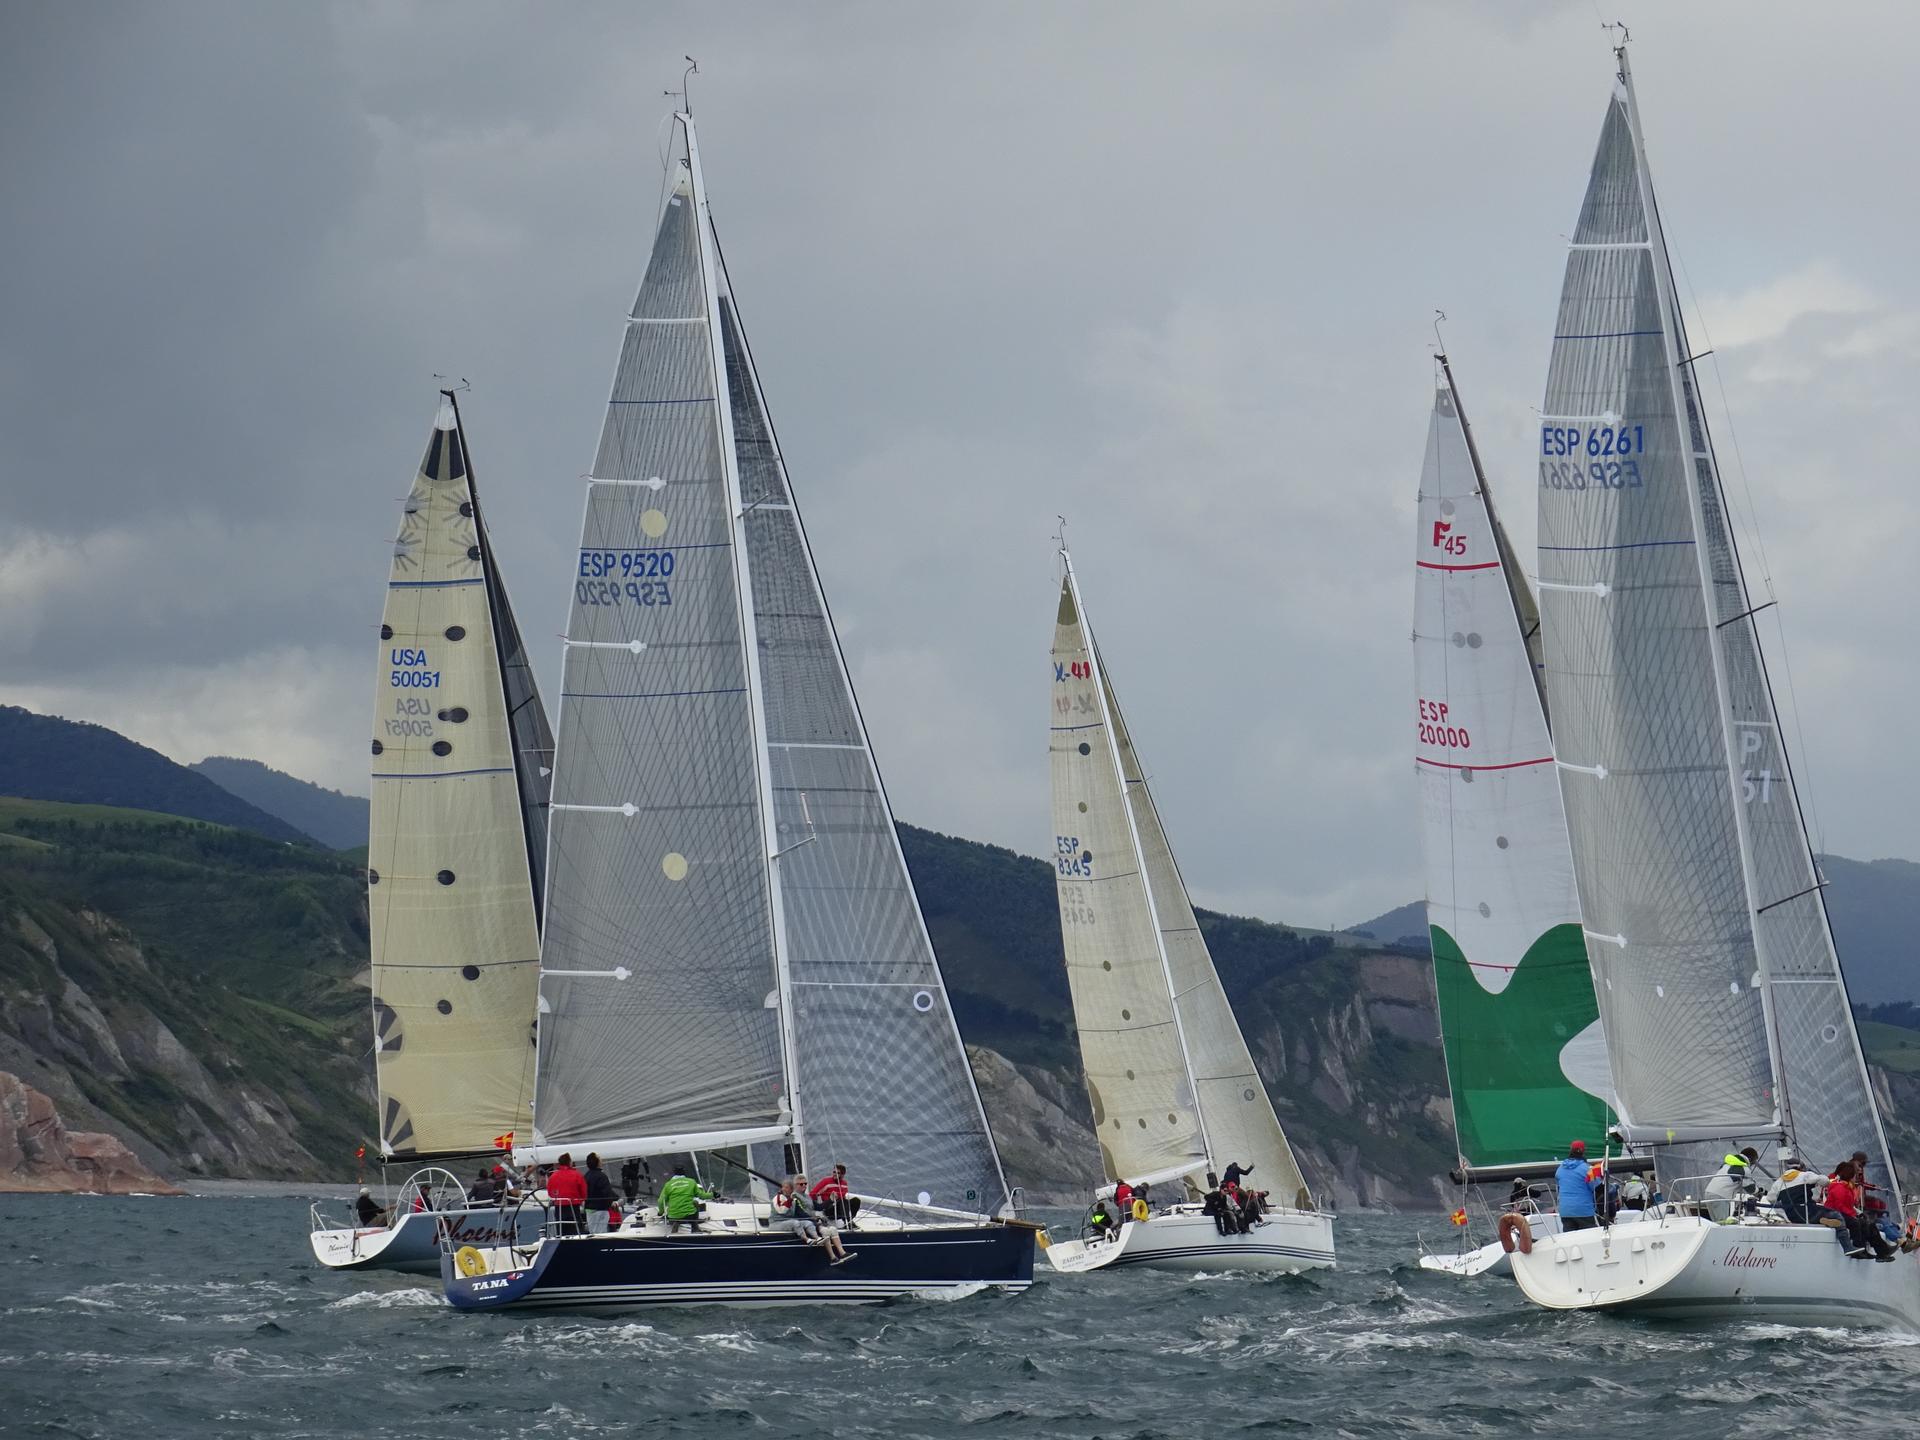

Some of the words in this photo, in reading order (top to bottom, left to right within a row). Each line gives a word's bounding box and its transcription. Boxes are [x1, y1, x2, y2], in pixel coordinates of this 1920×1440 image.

[1543, 427, 1581, 456] ESP
[1587, 425, 1644, 457] 6261
[580, 552, 616, 577] ESP
[620, 552, 675, 578] 9520
[391, 649, 427, 667] USA
[391, 671, 440, 688] 50051
[1418, 698, 1449, 723] ESP
[1418, 721, 1470, 748] 20000
[1057, 835, 1079, 855] ESP
[1058, 858, 1092, 877] 8345
[1712, 1246, 1778, 1269] Akelarre
[471, 1278, 510, 1291] TANA
